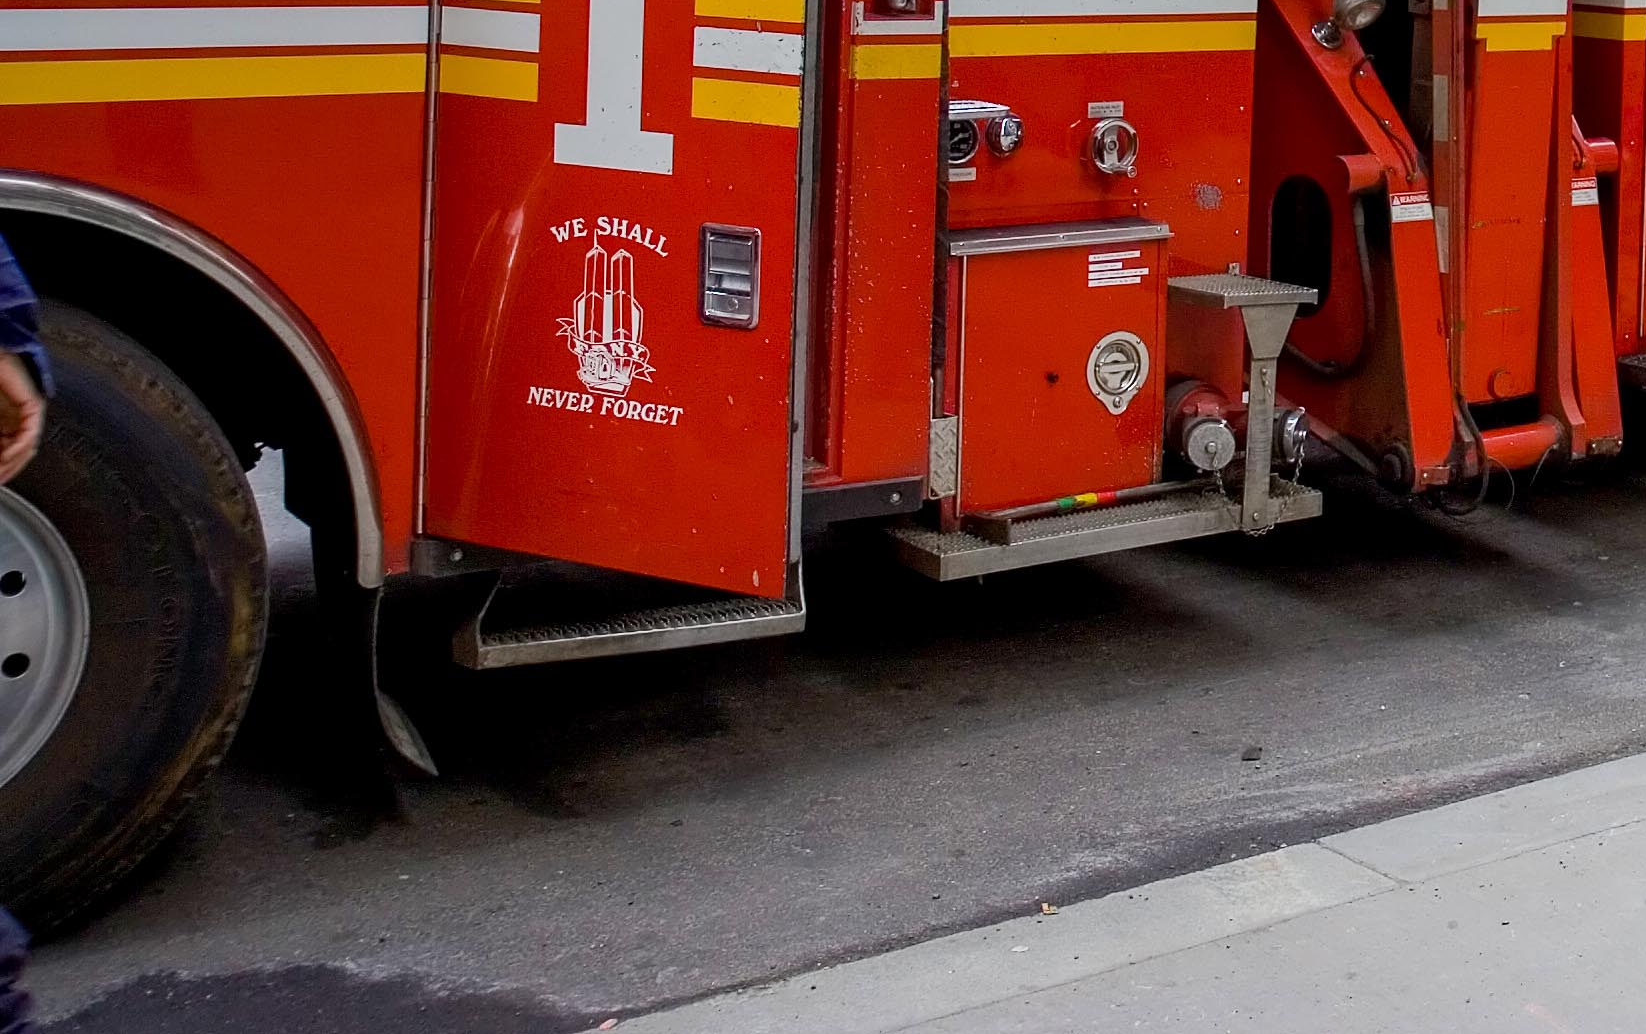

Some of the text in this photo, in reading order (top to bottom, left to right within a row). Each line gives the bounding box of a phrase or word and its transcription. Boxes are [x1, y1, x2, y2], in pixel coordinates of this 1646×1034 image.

[550, 216, 669, 257] WE SHALL
[526, 386, 684, 426] NEVER FORGET
